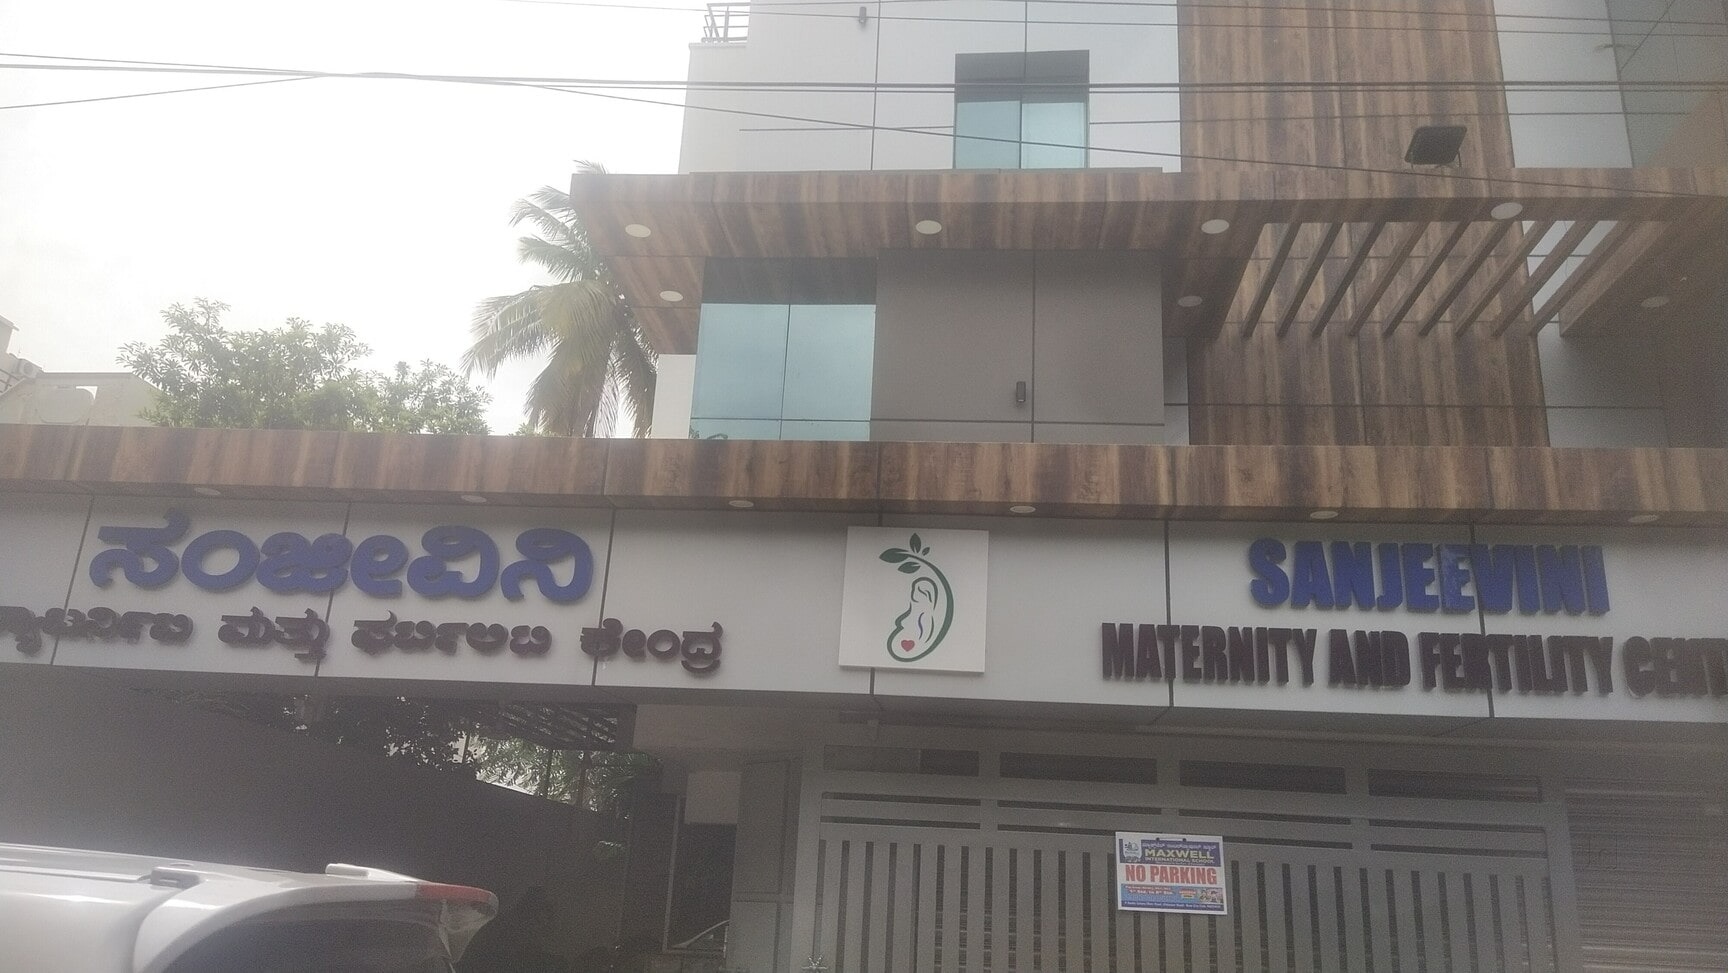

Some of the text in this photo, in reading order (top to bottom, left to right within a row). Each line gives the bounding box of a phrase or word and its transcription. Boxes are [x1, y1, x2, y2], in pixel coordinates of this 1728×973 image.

[89, 508, 594, 604] ಸಂಜೀವಿನಿ
[1249, 538, 1611, 613] SANJEEVINI
[218, 606, 330, 662] ಮತ್ತು
[580, 617, 723, 674] ಕೇಂದ್ರ
[1101, 622, 1728, 696] MATERNITY AND FERTILITY CENT
[1125, 864, 1217, 885] NO PARKING
[1146, 849, 1214, 860] MAXWELL
